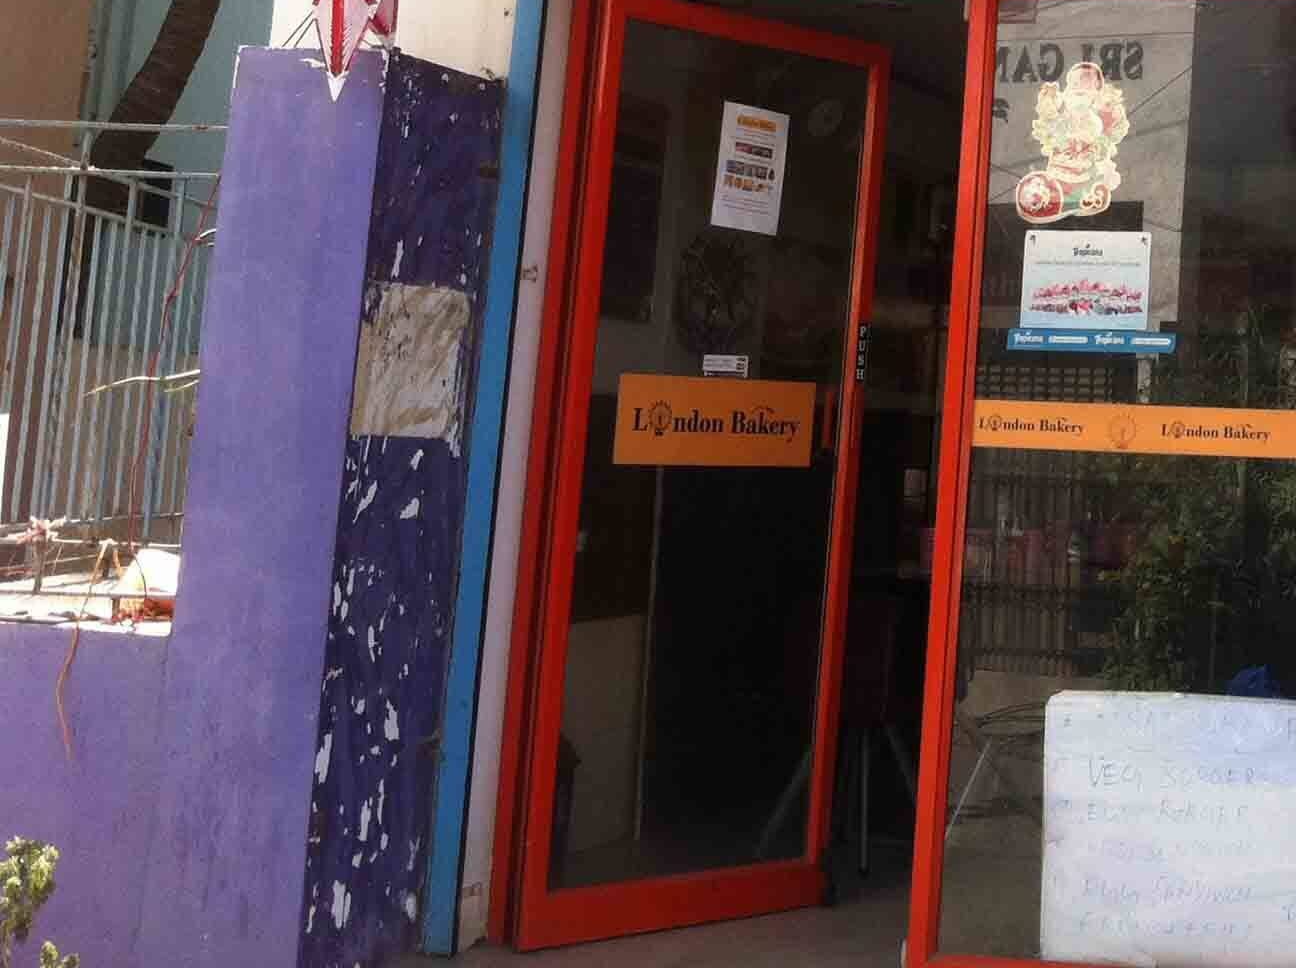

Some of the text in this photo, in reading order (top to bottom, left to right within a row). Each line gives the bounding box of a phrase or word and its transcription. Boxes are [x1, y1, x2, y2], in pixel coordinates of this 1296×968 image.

[632, 399, 801, 443] London Bakery
[978, 413, 1085, 436] London Bakery
[1161, 419, 1271, 442] London Bakery
